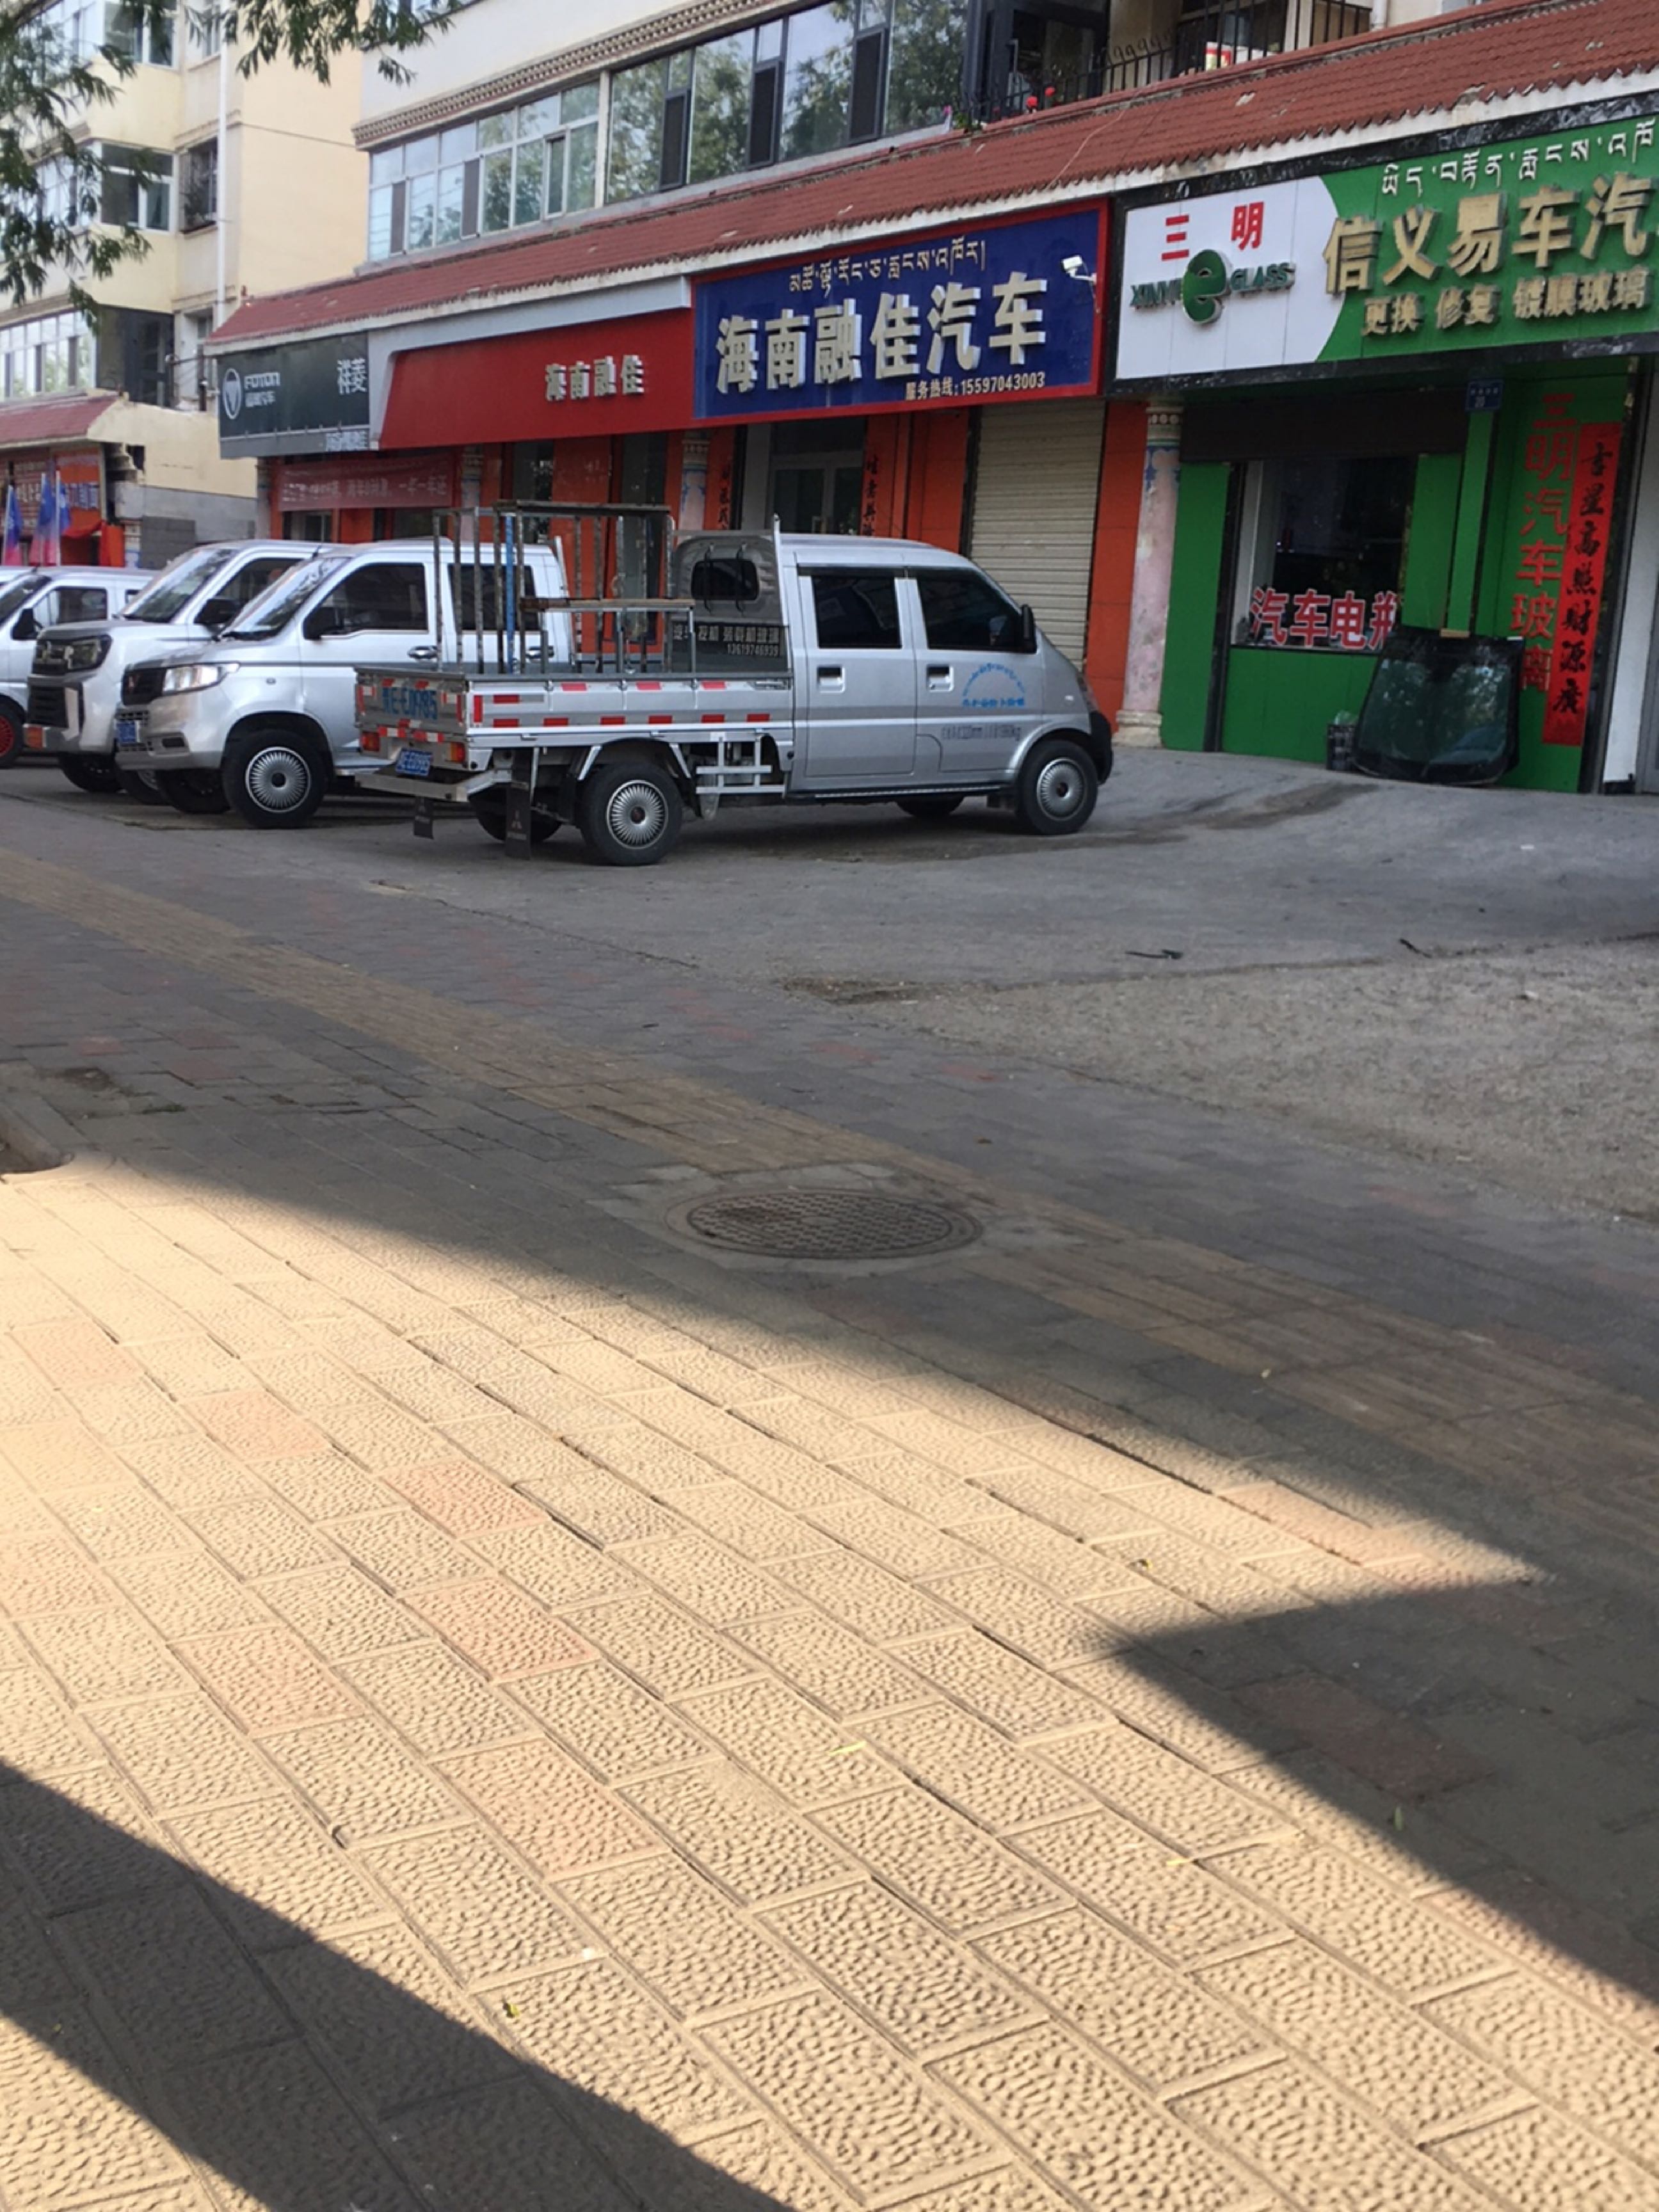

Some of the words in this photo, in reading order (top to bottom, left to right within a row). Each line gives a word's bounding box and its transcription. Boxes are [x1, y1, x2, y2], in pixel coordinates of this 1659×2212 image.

[1161, 201, 1265, 261] 三明
[1230, 262, 1296, 294] GLASS
[716, 271, 1048, 394] 海南融佳汽车
[1361, 292, 1423, 337] 更换
[1435, 282, 1500, 330] 修复
[545, 355, 644, 401] 海南融佳
